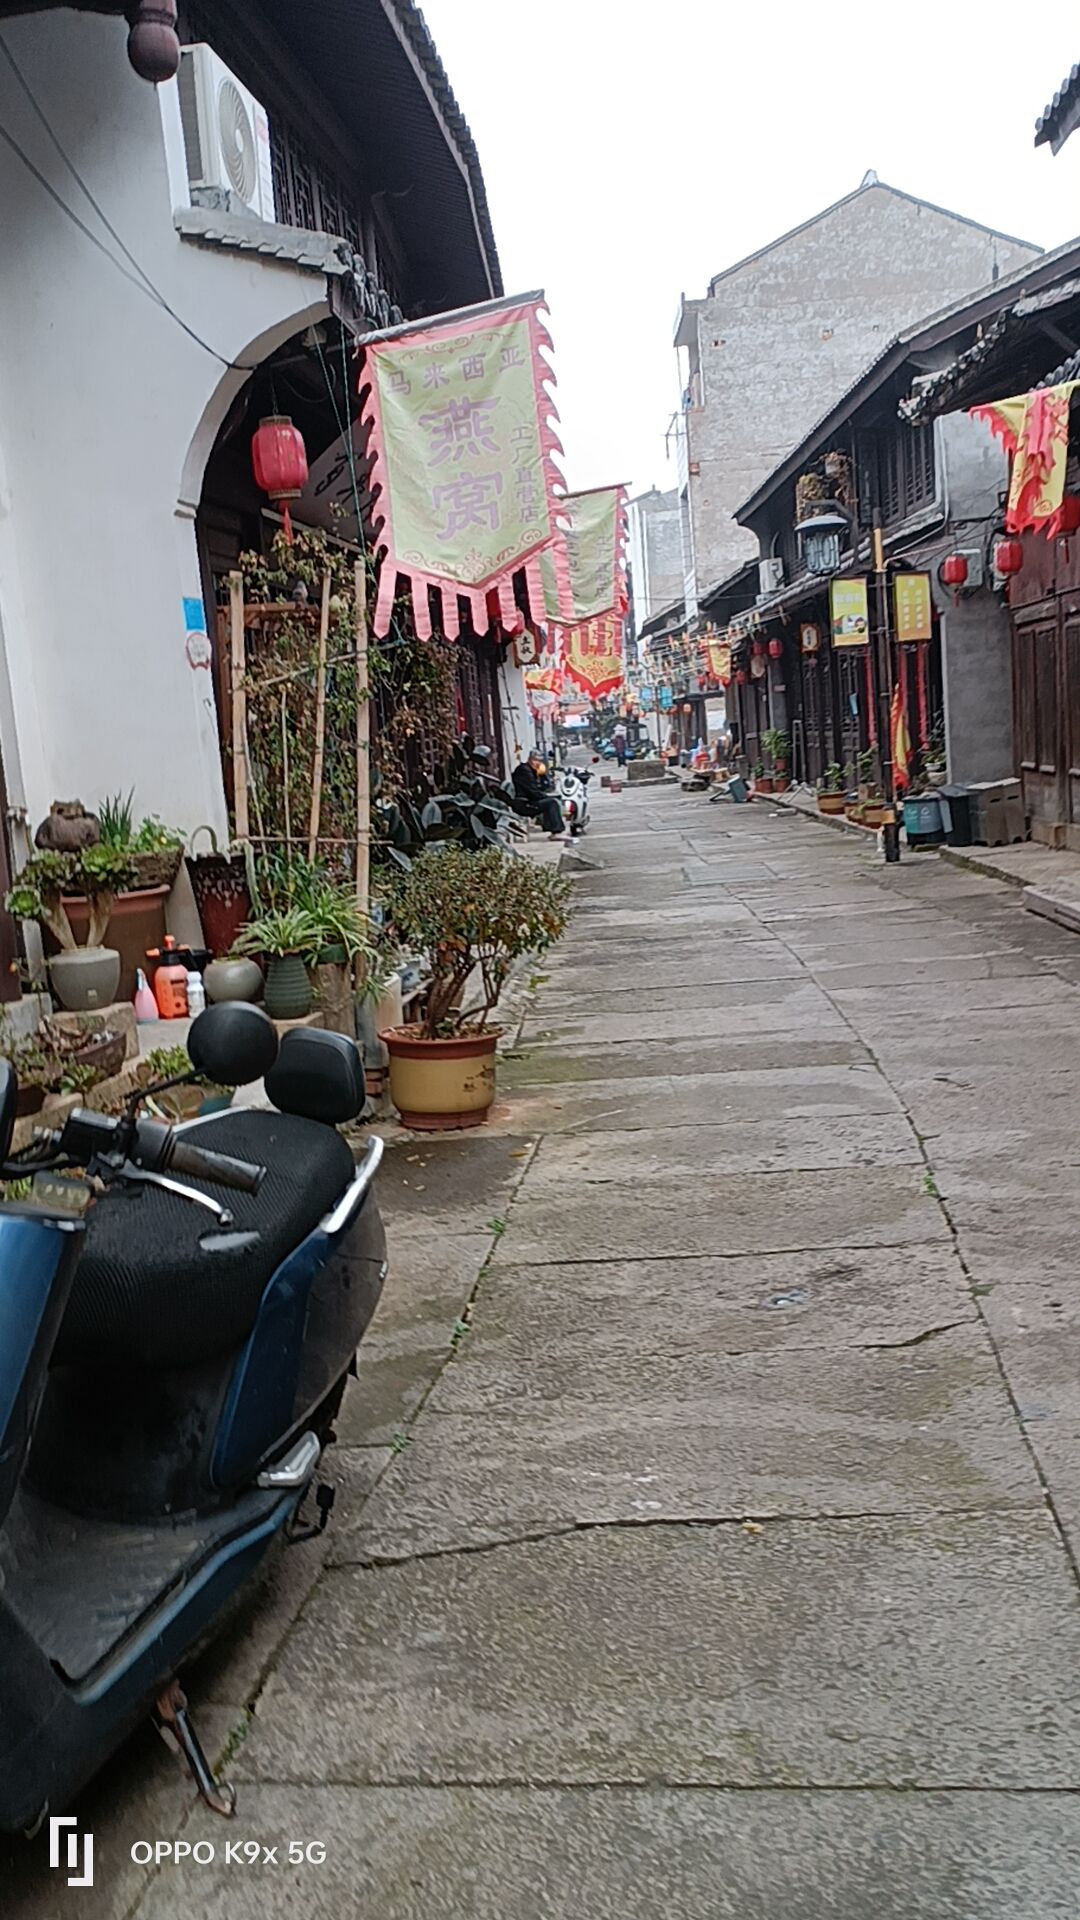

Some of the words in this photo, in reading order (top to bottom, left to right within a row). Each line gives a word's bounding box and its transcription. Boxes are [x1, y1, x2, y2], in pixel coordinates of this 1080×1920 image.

[386, 344, 526, 395] 马来西亚
[417, 396, 503, 540] 燕窝
[510, 425, 540, 524] 工厂直营店
